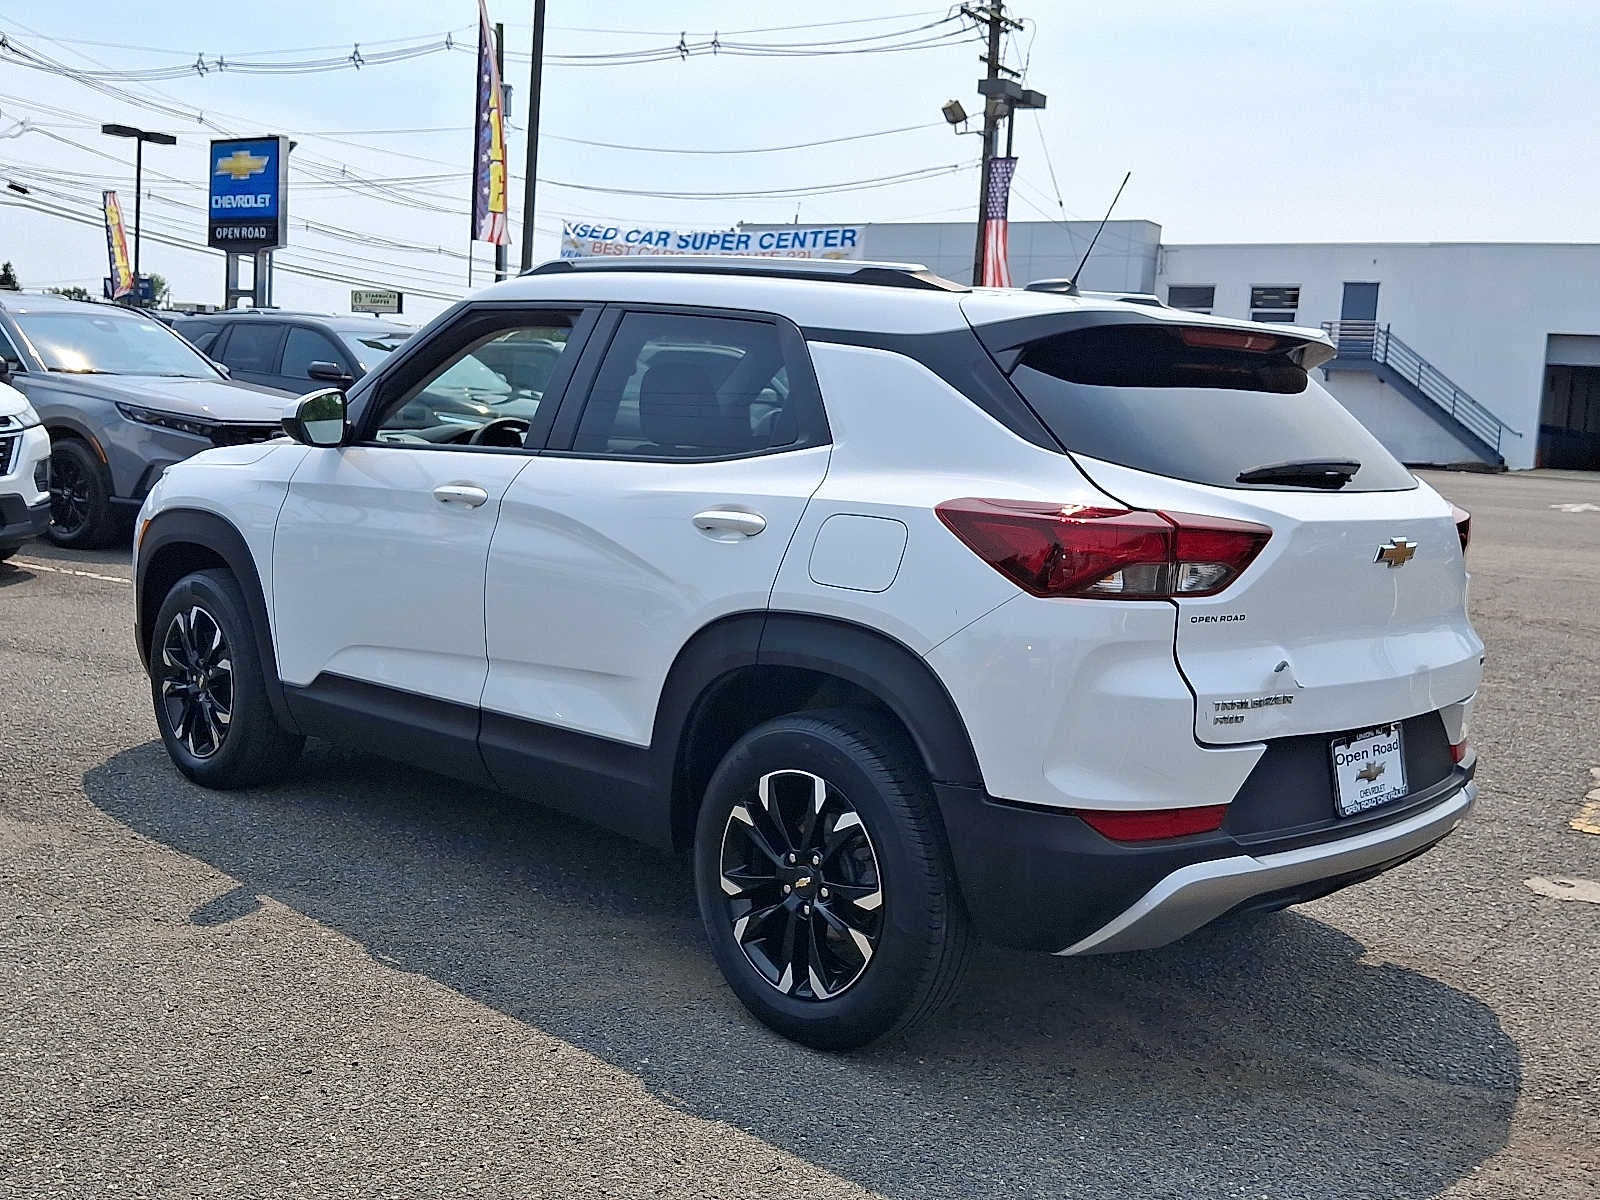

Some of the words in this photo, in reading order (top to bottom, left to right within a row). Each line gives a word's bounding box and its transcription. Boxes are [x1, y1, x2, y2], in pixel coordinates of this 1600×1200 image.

[211, 194, 272, 209] CHEVROLET
[215, 226, 240, 239] OPEN
[241, 226, 267, 239] ROAD
[564, 223, 618, 241] USED
[625, 229, 671, 247] CAR
[677, 232, 751, 250] SUPER
[759, 229, 857, 250] CENTER
[591, 241, 635, 256] BEST
[1190, 616, 1218, 624] OPEN
[1219, 614, 1246, 623] ROAD
[1336, 750, 1368, 766] Open
[1372, 739, 1399, 757] Road
